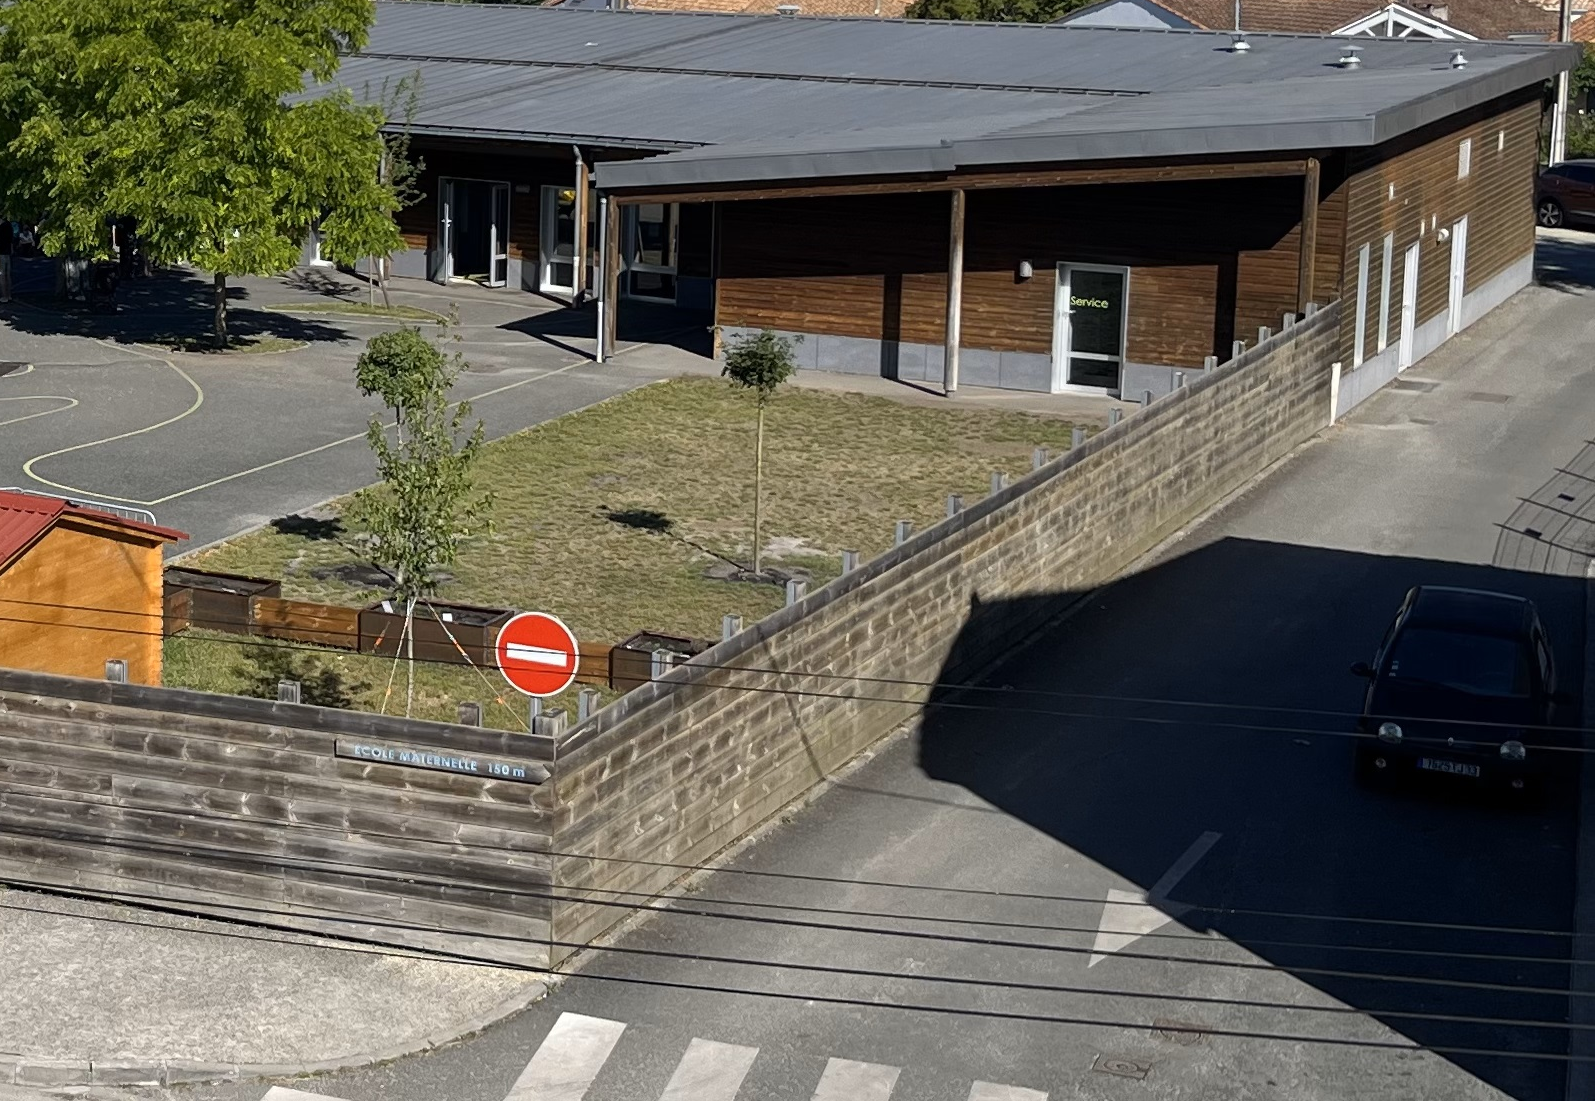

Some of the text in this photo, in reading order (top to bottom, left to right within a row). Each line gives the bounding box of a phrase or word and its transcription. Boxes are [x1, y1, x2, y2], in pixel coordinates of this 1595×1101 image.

[1070, 295, 1109, 309] Service
[399, 751, 477, 771] MATERNELLE
[487, 762, 510, 775] 150
[512, 767, 525, 778] m
